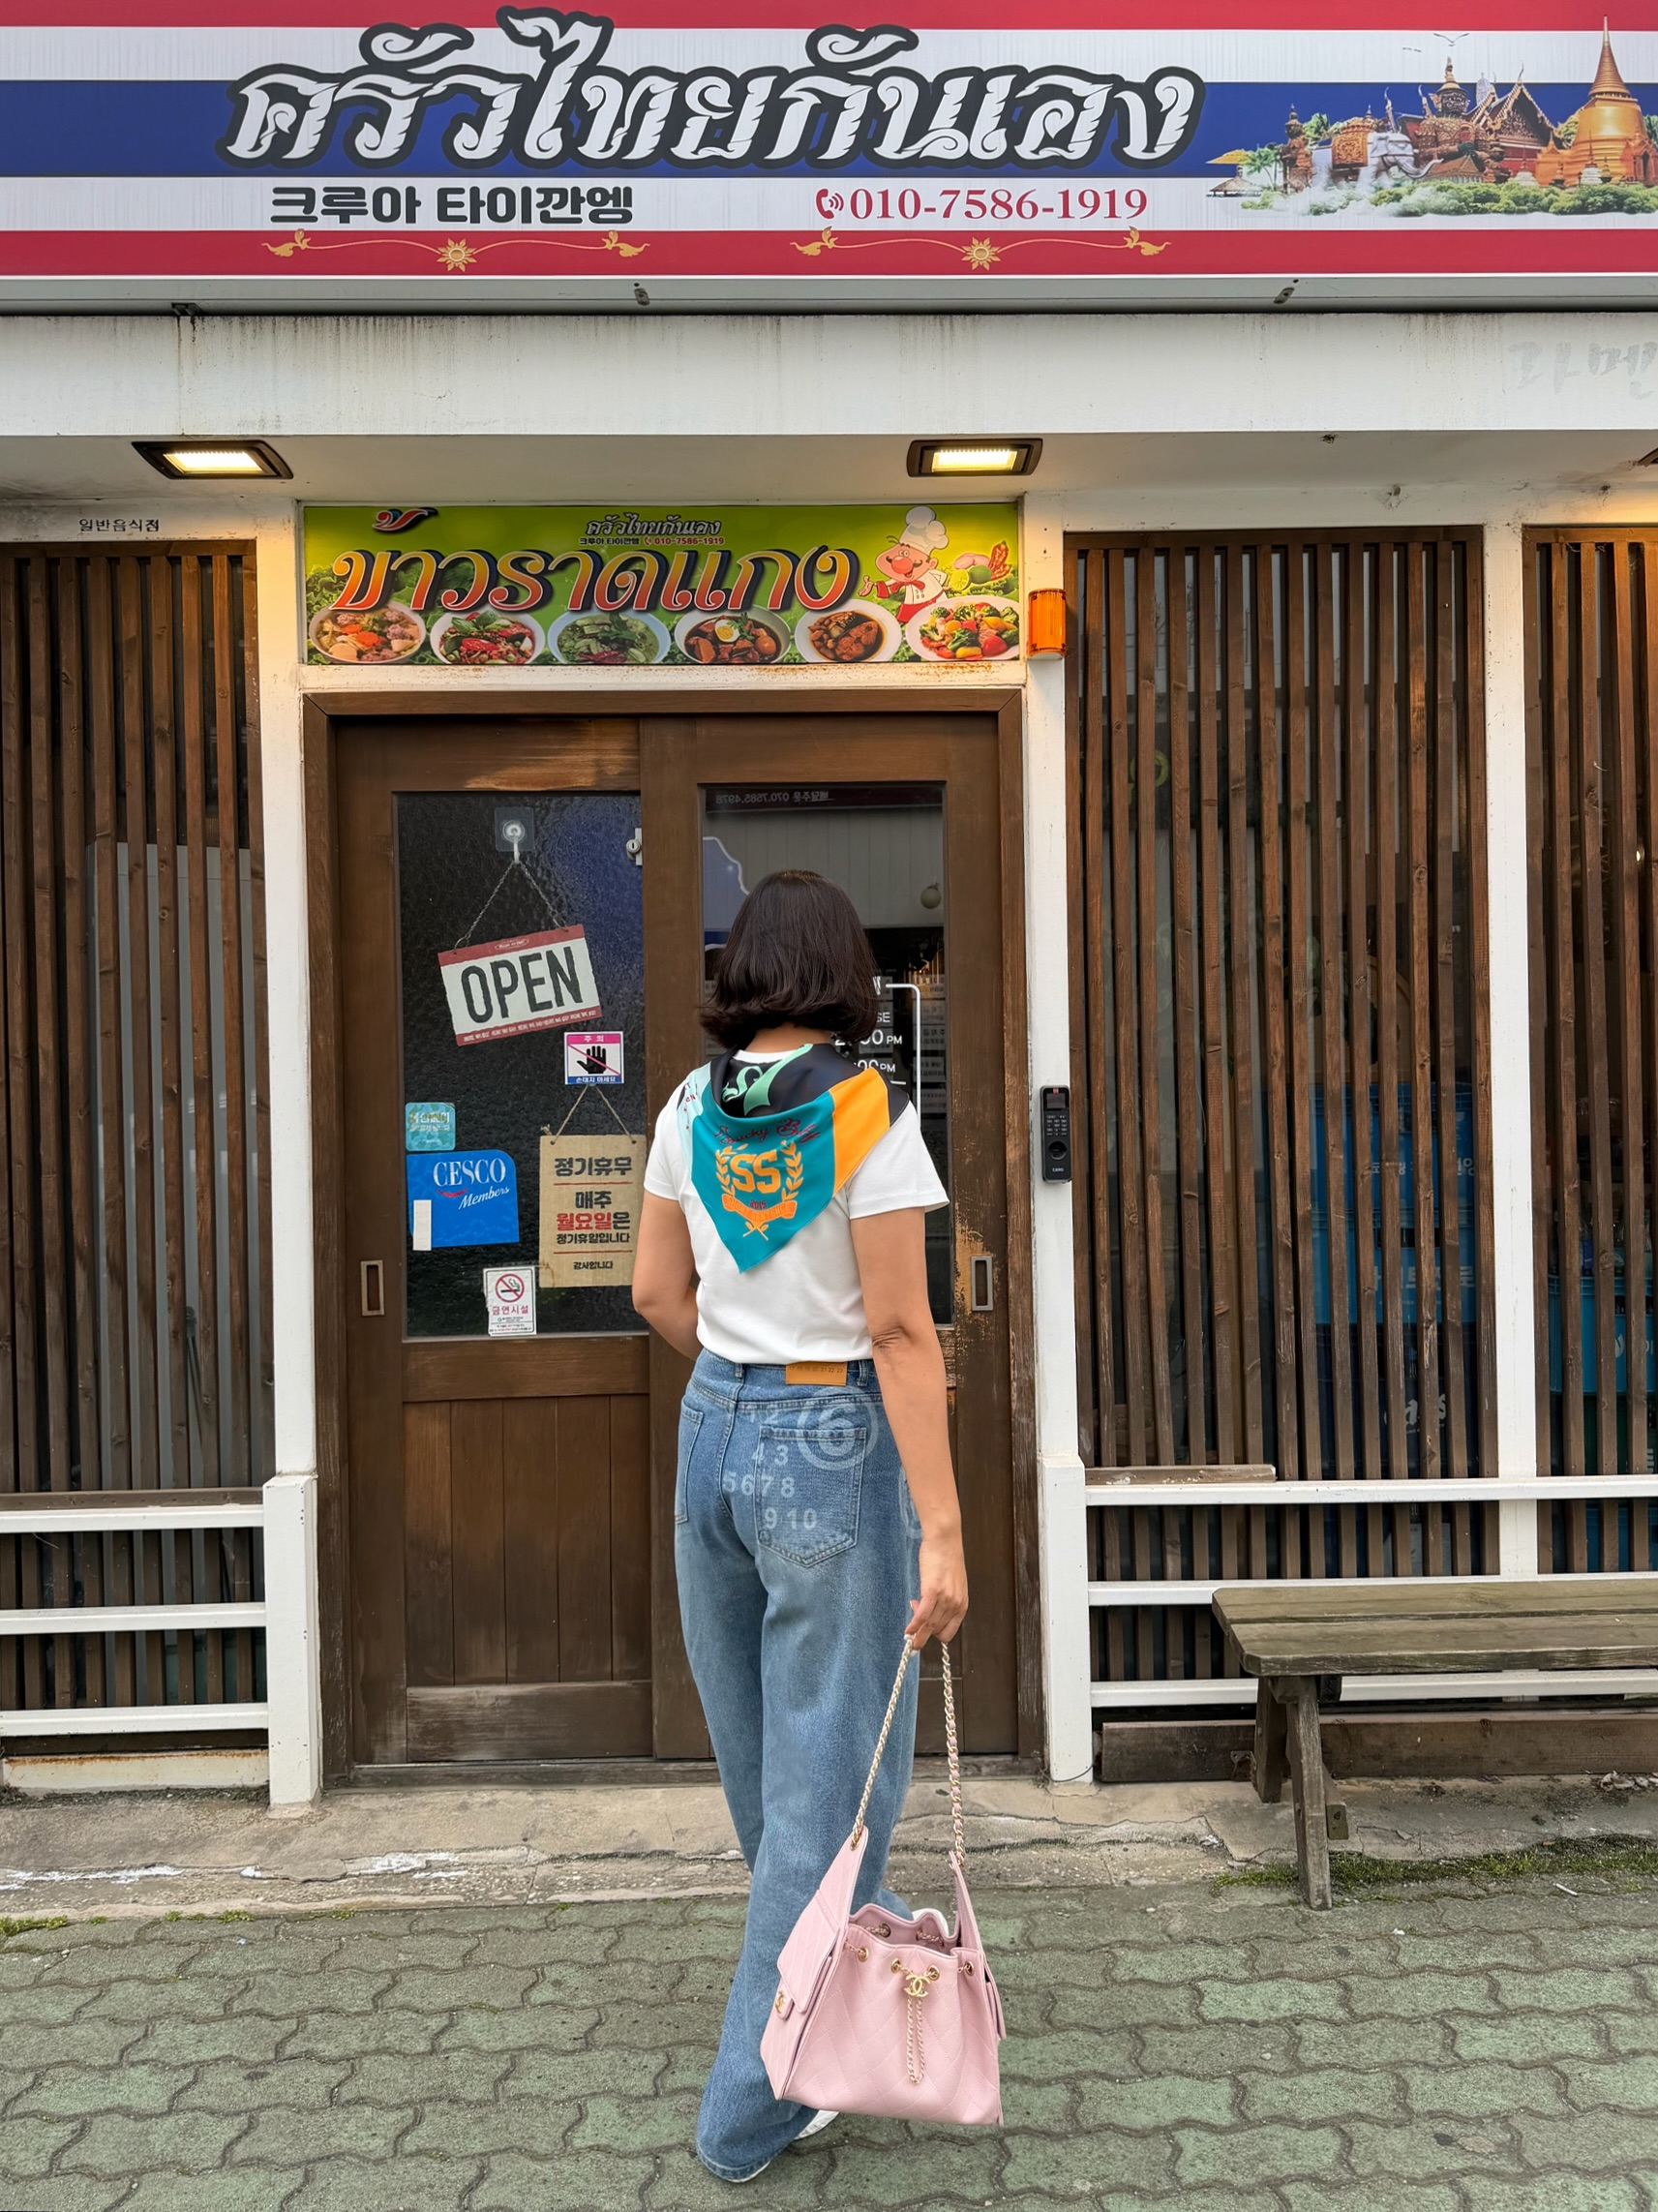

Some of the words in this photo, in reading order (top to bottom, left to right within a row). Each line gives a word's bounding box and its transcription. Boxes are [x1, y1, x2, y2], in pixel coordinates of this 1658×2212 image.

[270, 185, 422, 225] 크루아
[849, 188, 1148, 221] 010-7586-1919
[78, 518, 160, 532] 일반음식점
[461, 946, 584, 1023] OPEN
[887, 1036, 903, 1045] PM
[433, 1158, 506, 1188] CESCO
[554, 1156, 633, 1177] 정기휴무
[730, 1149, 781, 1194] SS
[458, 1186, 510, 1210] Members
[575, 1191, 612, 1209] 매주
[557, 1211, 631, 1230] 월요일은
[557, 1233, 631, 1245] 정기휴일입니다
[492, 1304, 529, 1316] 금연시설
